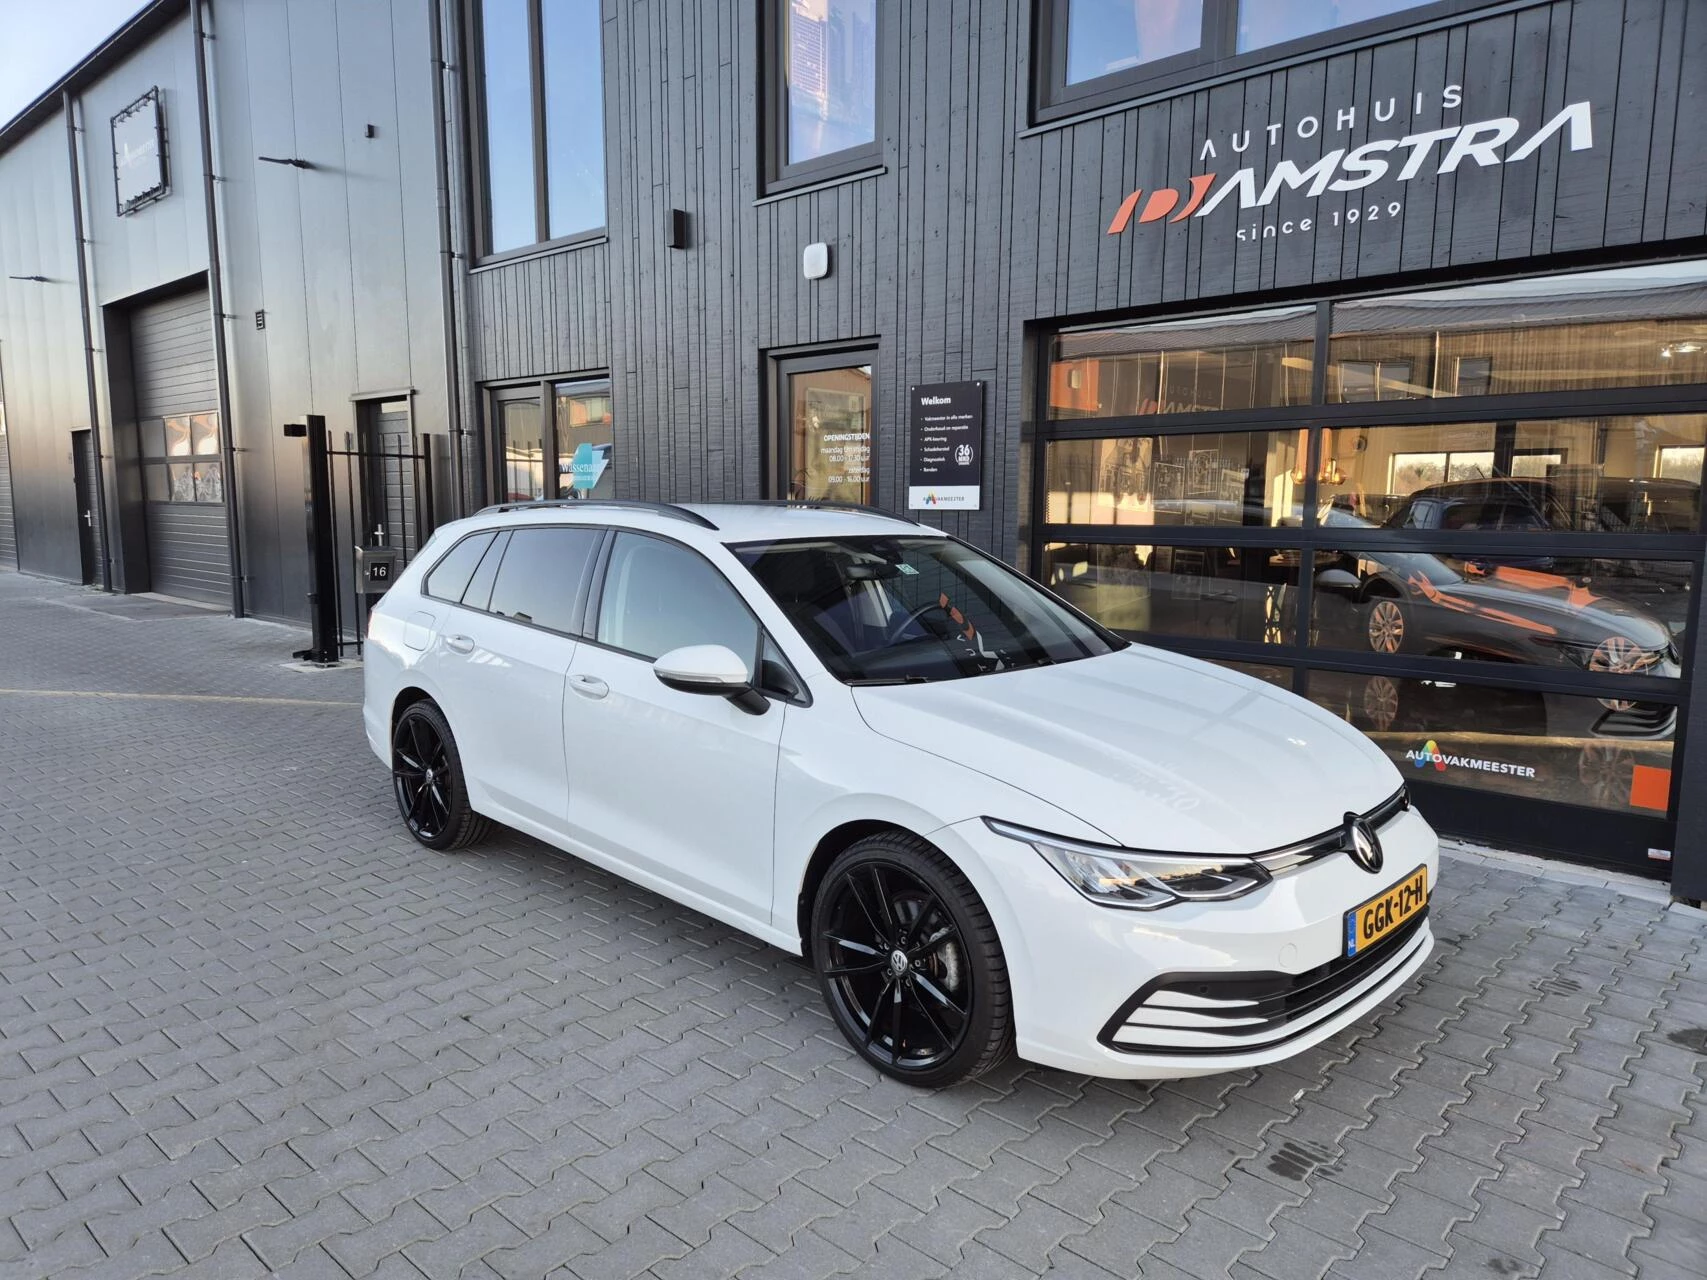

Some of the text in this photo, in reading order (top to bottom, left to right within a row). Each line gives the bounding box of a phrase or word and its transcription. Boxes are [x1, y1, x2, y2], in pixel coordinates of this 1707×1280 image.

[1199, 84, 1463, 161] AUTOHUIS
[1236, 202, 1402, 242] since 1929
[920, 396, 952, 406] Welkom
[958, 444, 971, 456] 36
[372, 566, 387, 577] 16
[1405, 749, 1536, 779] AUTOVAKMEESTER
[1363, 874, 1423, 940] GGK-12-H
